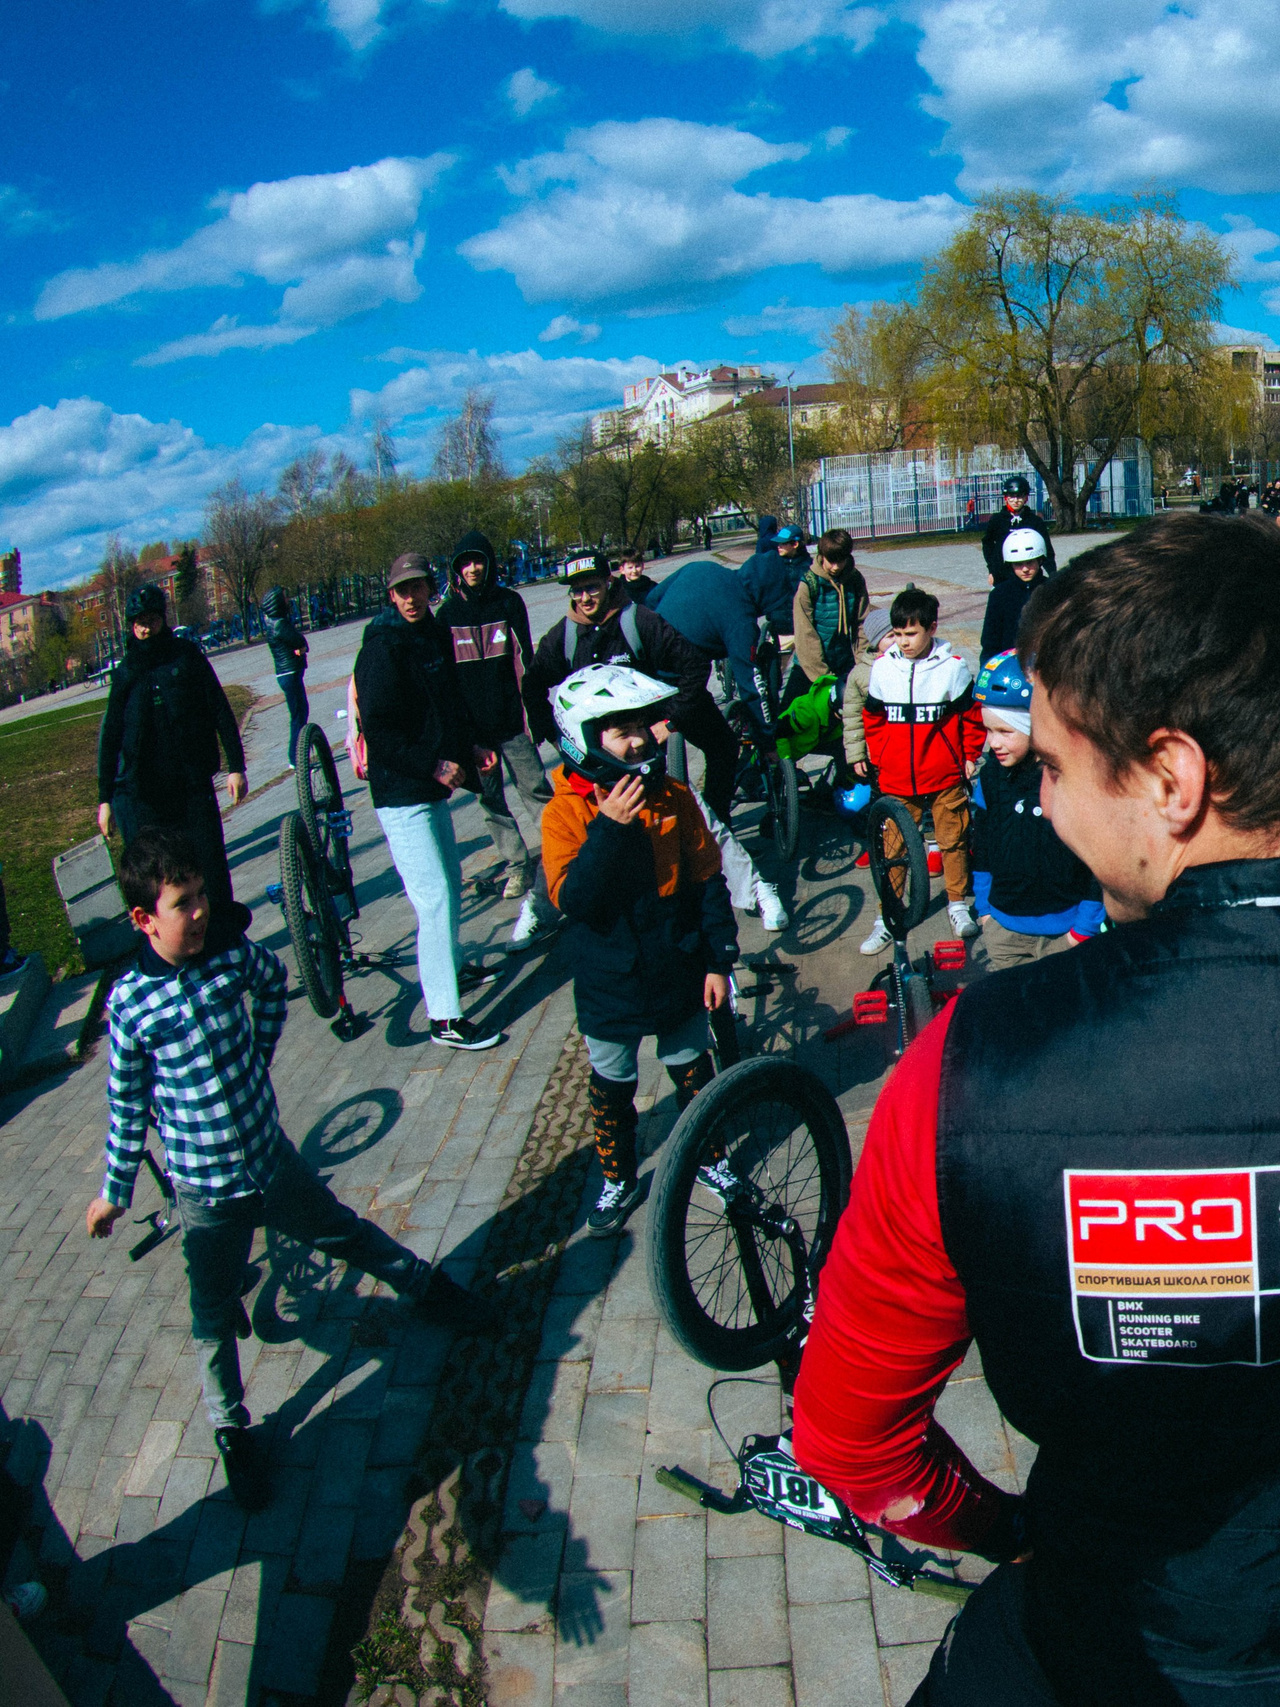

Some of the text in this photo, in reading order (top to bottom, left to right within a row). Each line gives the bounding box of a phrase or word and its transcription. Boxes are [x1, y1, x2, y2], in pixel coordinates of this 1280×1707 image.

[1077, 1197, 1243, 1241] PRO
[1077, 1274, 1251, 1286] СПОРТИВШАЯ ШКОЛА ГОНОК
[1117, 1301, 1144, 1311] BMX
[1118, 1314, 1201, 1324] RUNNING BIKE
[1119, 1326, 1173, 1337] SCOOTER
[1120, 1338, 1198, 1348] SKATEBOARD
[1122, 1349, 1149, 1358] BIKE
[770, 1470, 825, 1511] 181
